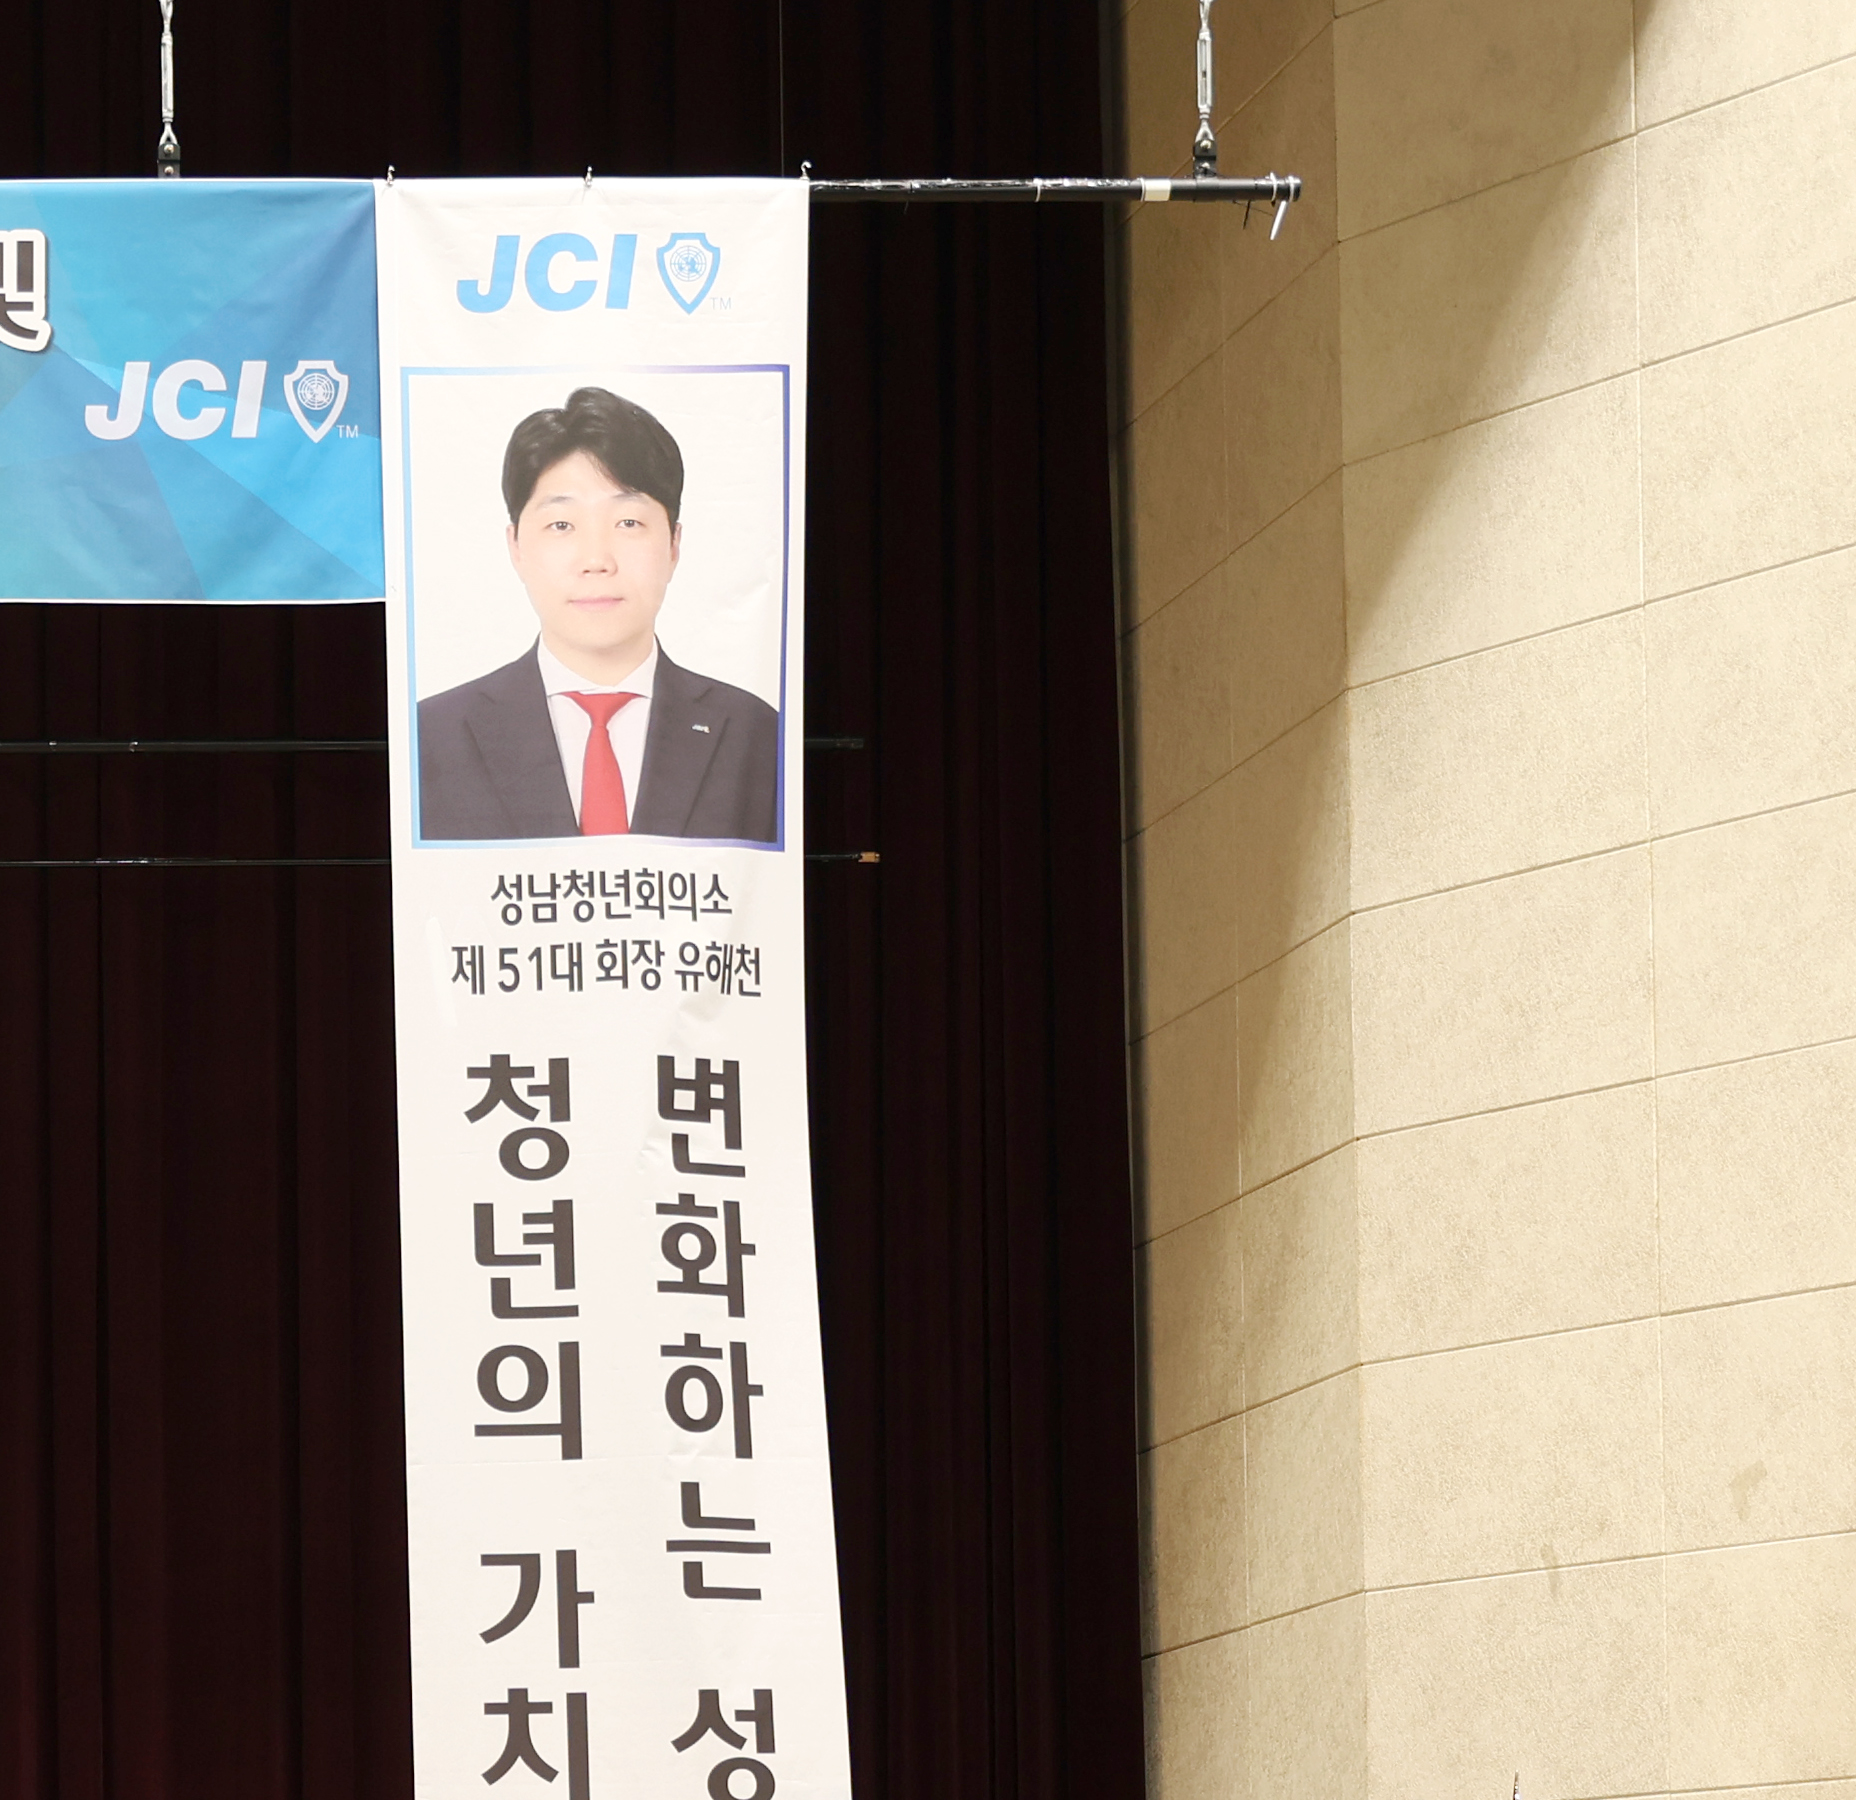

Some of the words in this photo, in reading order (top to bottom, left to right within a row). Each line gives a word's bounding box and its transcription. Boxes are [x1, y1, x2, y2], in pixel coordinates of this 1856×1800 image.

[456, 233, 638, 314] JCI
[709, 297, 732, 310] TM
[85, 360, 261, 440] JCI
[337, 424, 360, 440] TM
[489, 866, 734, 927] 성남청년회의소
[450, 944, 487, 996] 제
[496, 943, 585, 997] 51대
[593, 935, 667, 995] 회장
[673, 939, 764, 999] 유해천
[463, 1053, 585, 1461] 청년의
[655, 1054, 773, 1601] 변화하는
